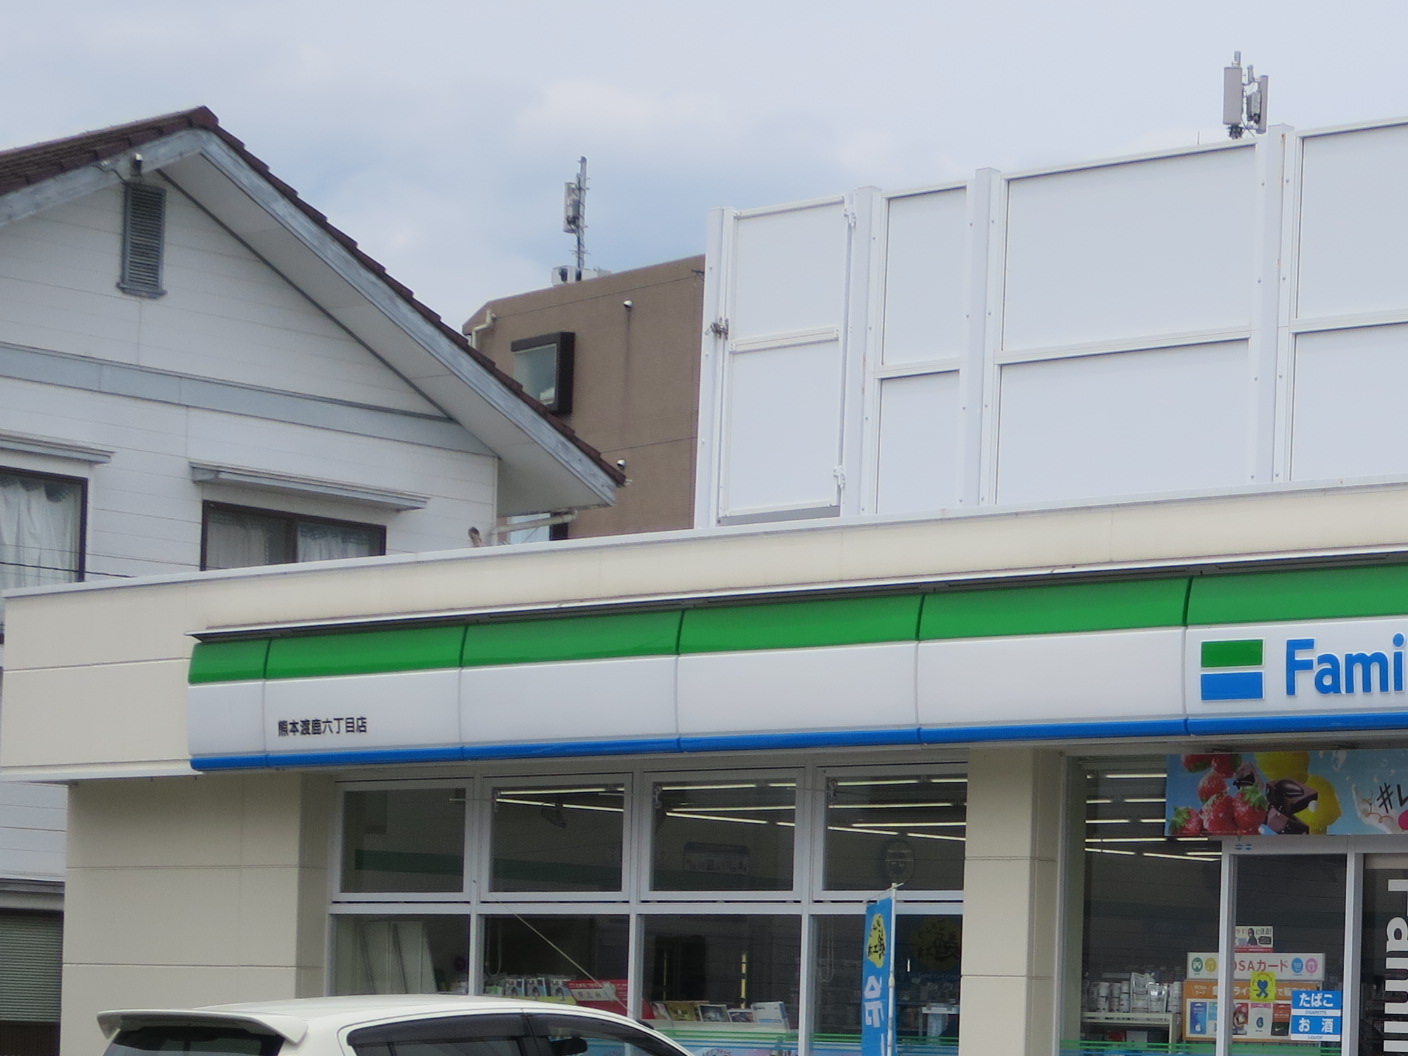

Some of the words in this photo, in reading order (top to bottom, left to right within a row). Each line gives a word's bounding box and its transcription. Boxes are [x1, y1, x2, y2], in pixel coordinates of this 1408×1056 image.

[278, 717, 367, 737] 熊本渡鹿六丁目店
[1299, 993, 1333, 1007] たばこ
